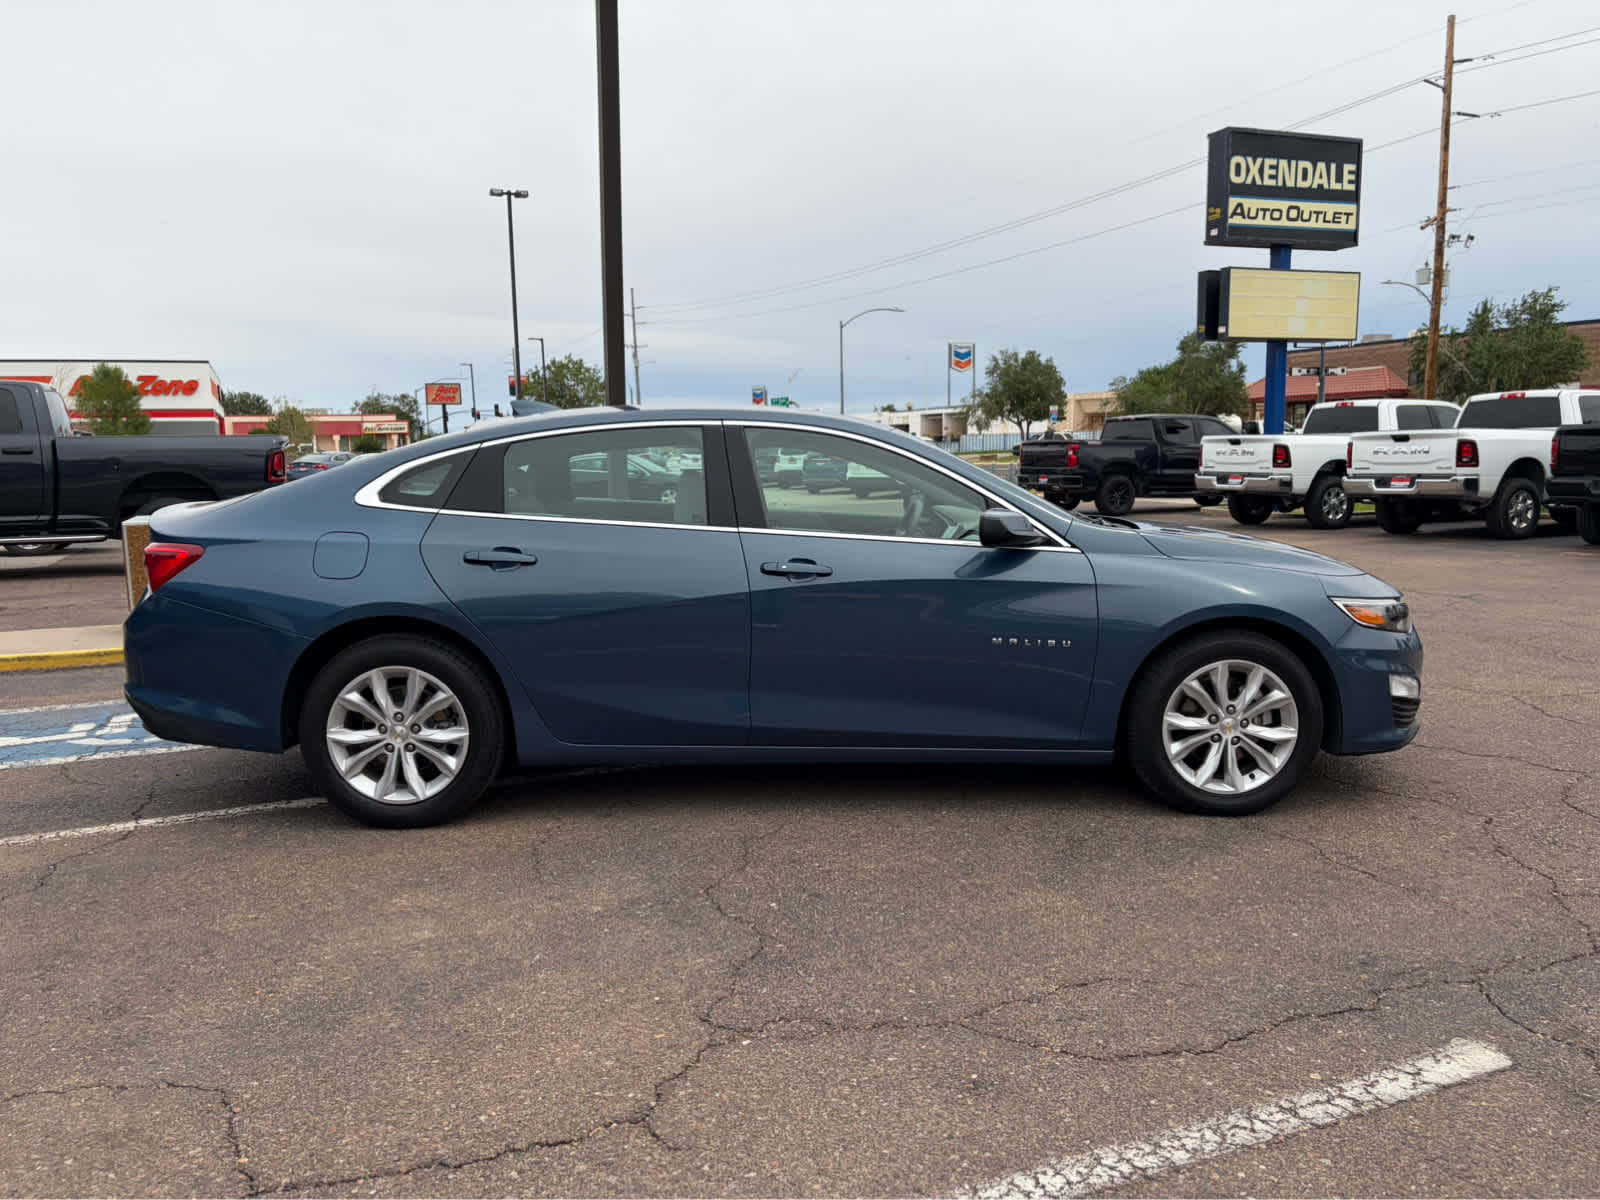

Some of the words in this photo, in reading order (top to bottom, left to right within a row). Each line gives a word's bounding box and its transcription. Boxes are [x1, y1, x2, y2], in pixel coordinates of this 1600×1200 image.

[1229, 155, 1357, 191] OXENDALE
[1229, 202, 1283, 221] AUTO
[1286, 205, 1354, 225] OUTLET
[991, 636, 1072, 648] MALIBU
